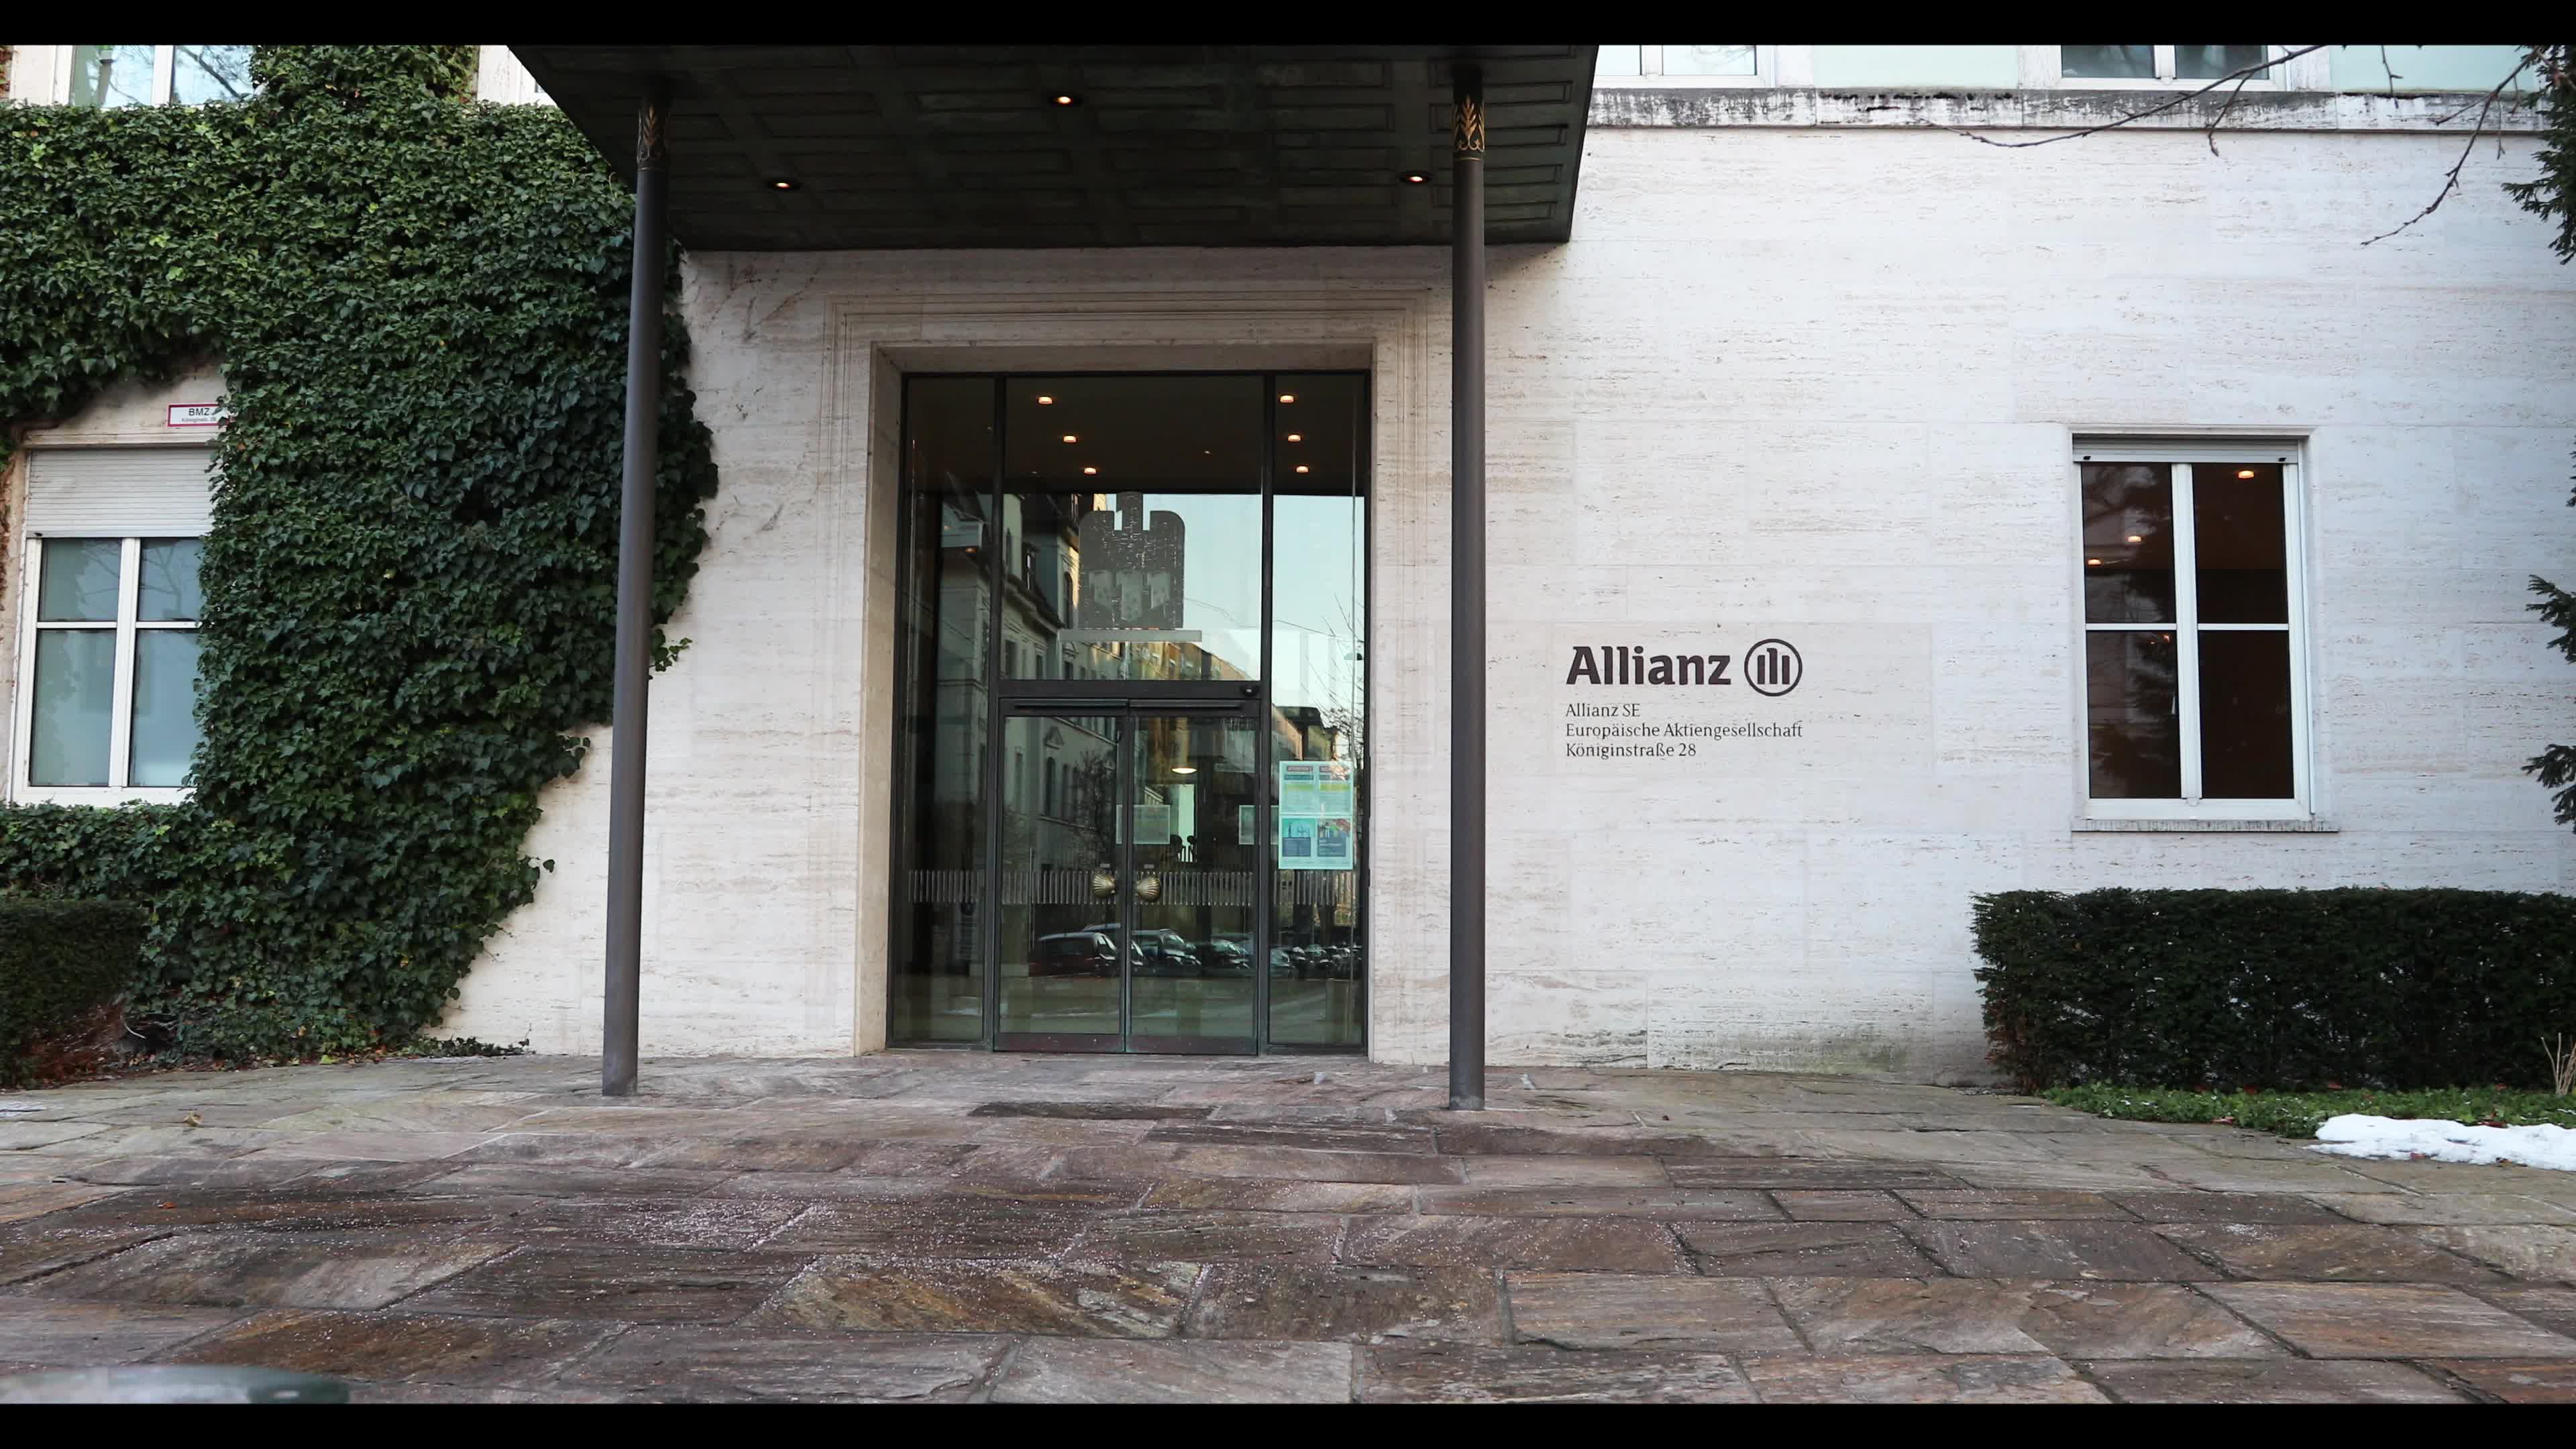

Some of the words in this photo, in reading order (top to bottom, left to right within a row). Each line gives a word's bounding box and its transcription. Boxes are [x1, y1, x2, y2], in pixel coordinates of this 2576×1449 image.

[189, 408, 210, 416] BMZ
[1566, 645, 1731, 685] Allianz
[1566, 702, 1619, 717] Allianz
[1622, 702, 1640, 717] SE
[1566, 722, 1660, 740] Europäische
[1663, 722, 1803, 740] Aktiengesellschaft
[1566, 742, 1674, 759] Königinstraße
[1678, 743, 1697, 757] 28
